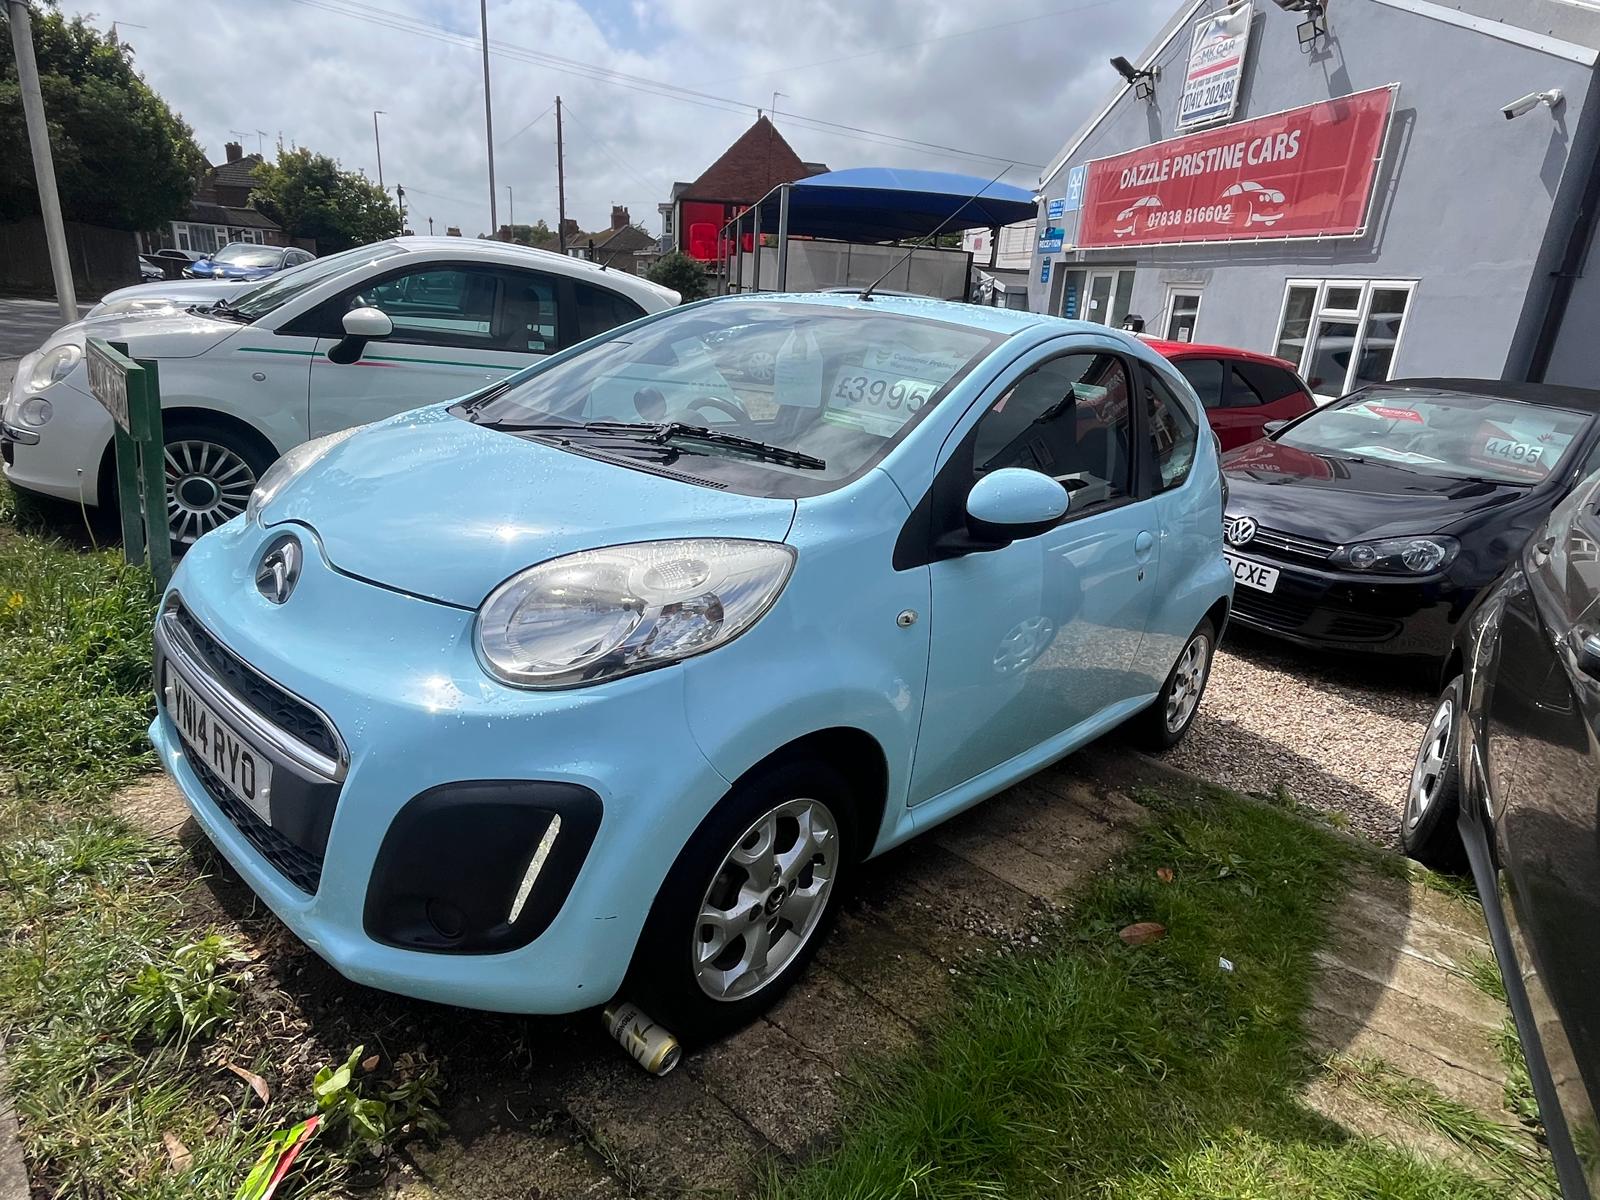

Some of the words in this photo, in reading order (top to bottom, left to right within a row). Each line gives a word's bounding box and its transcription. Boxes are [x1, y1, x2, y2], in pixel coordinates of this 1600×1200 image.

[1216, 40, 1235, 54] CAR
[1119, 158, 1171, 190] DAZZLE
[1171, 141, 1246, 179] PRISTINE
[1247, 129, 1301, 166] CARS
[1147, 209, 1181, 228] 07838
[1184, 203, 1232, 225] 816602
[1039, 239, 1061, 249] RECEPTION
[834, 375, 930, 414] £3995
[1486, 441, 1540, 464] 4495
[1234, 562, 1271, 587] CXE
[173, 678, 209, 755] YN14
[212, 721, 255, 801] RYO
